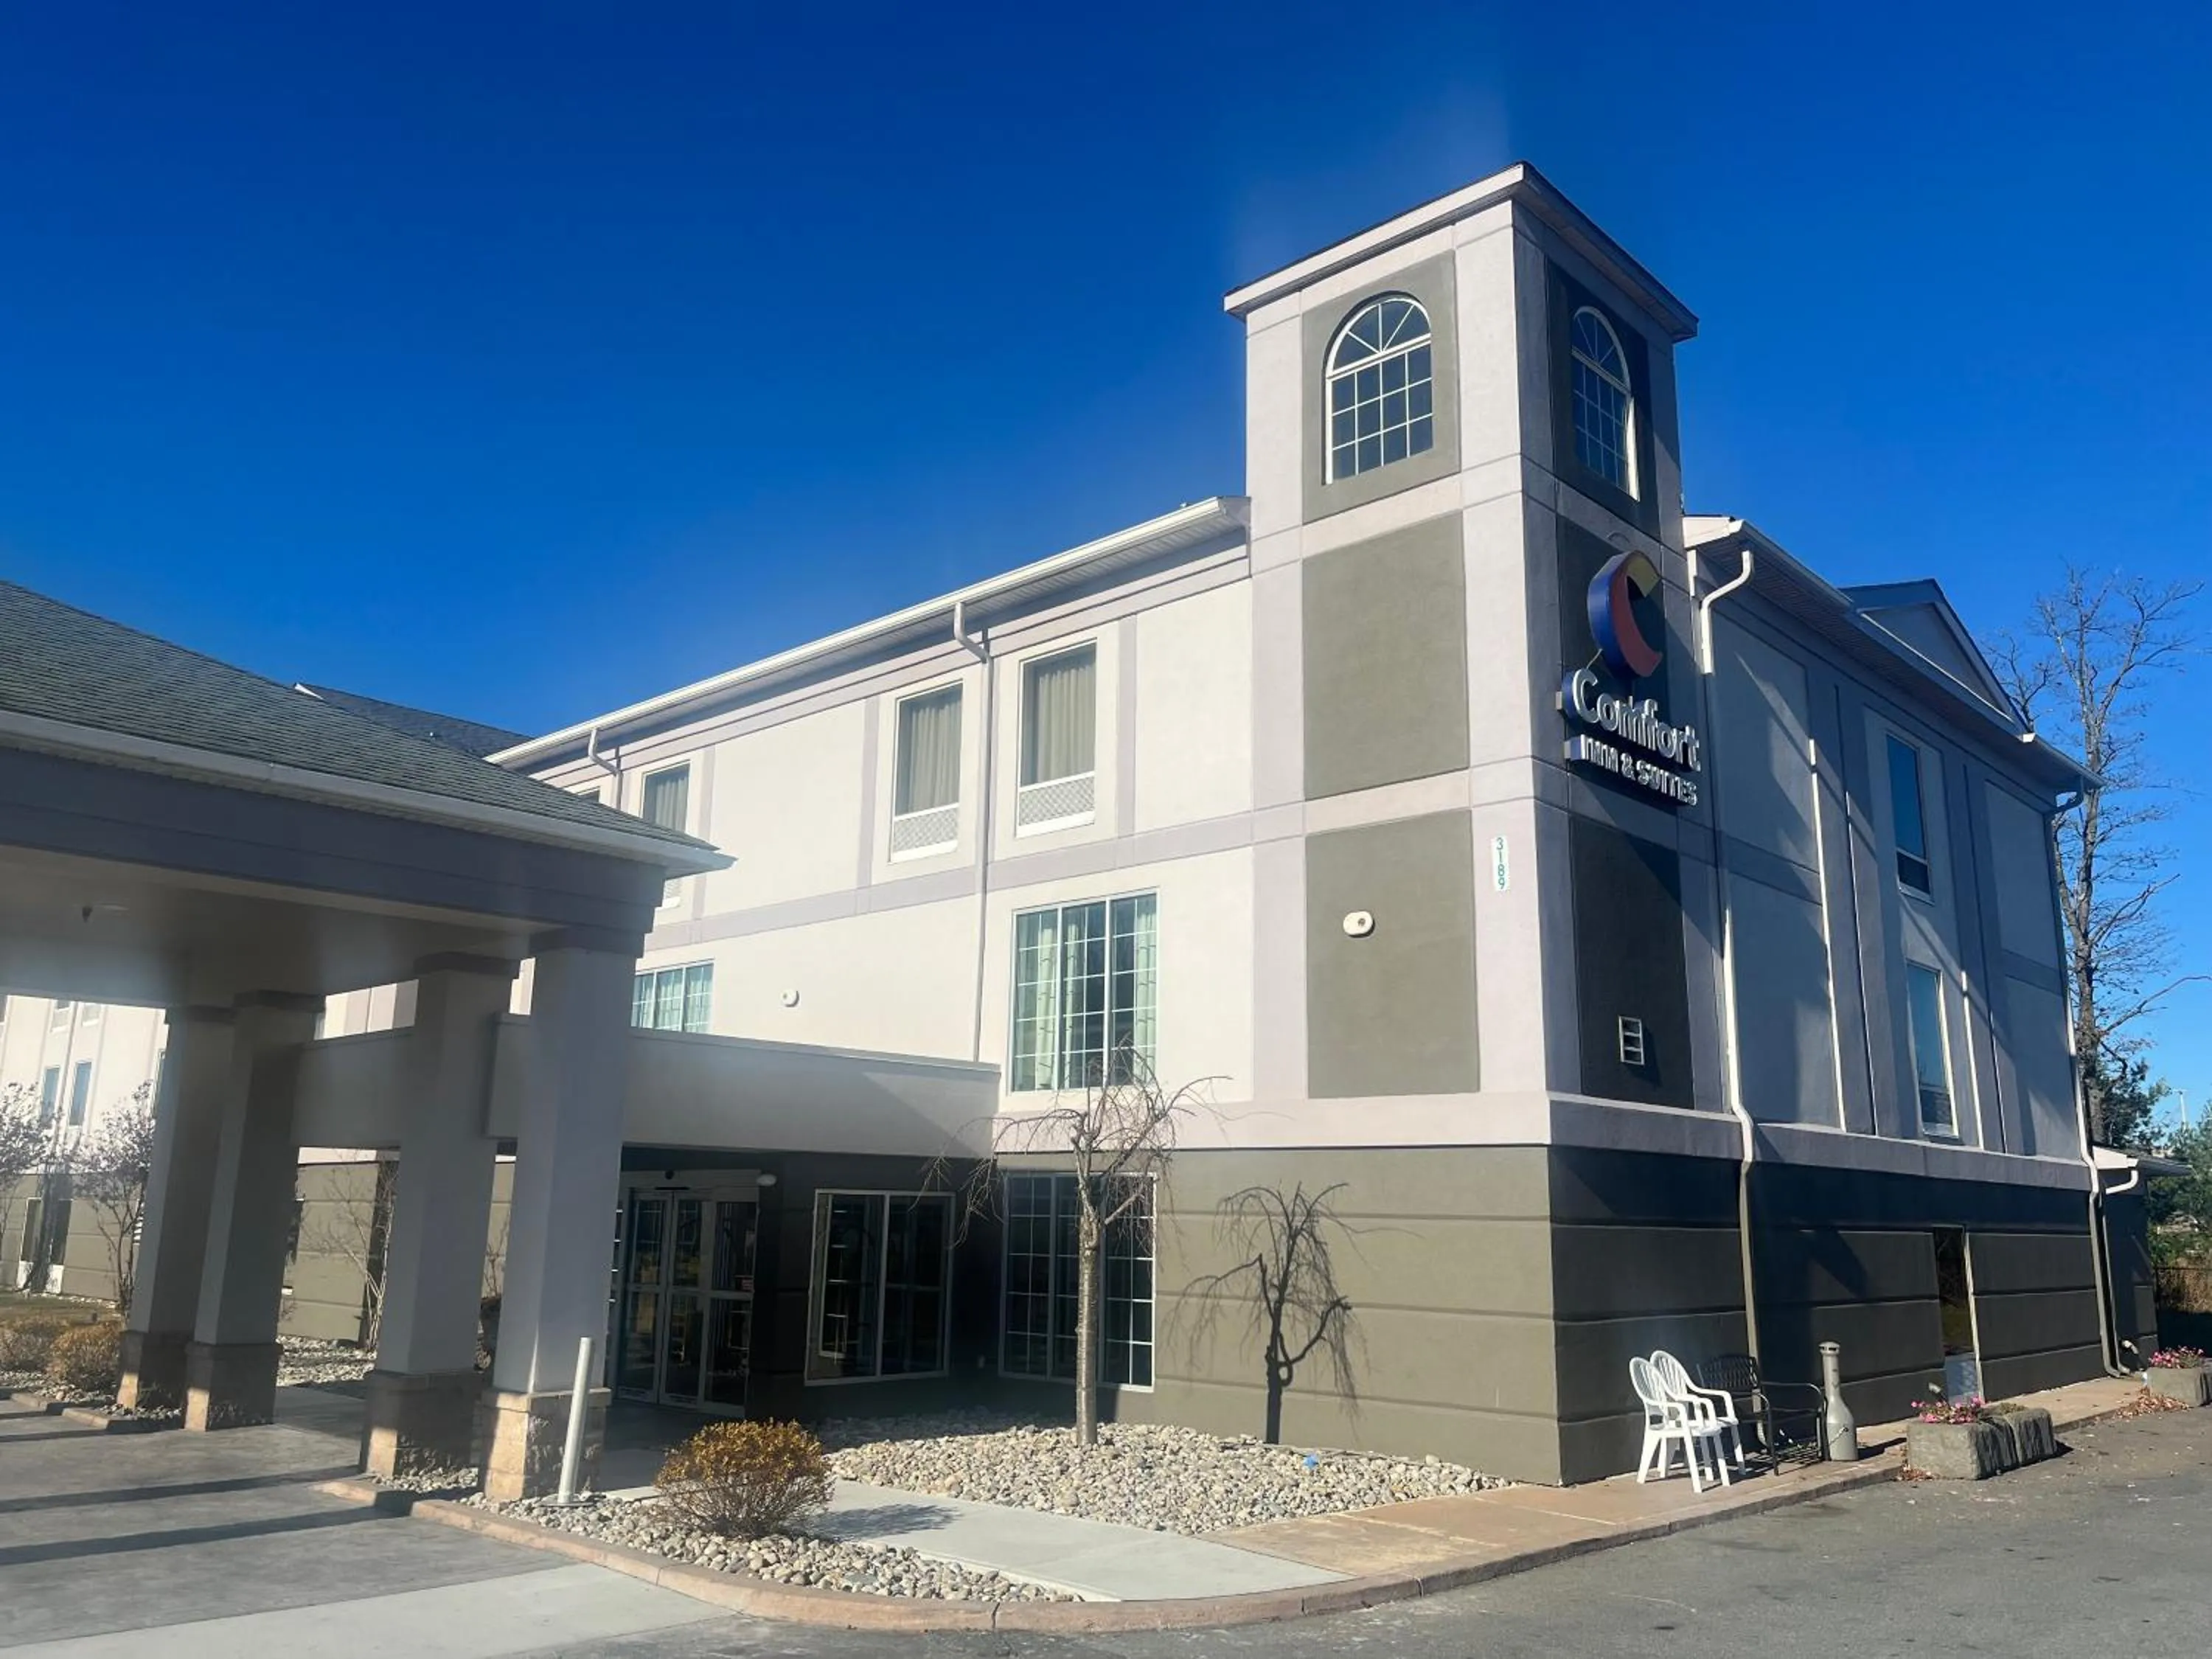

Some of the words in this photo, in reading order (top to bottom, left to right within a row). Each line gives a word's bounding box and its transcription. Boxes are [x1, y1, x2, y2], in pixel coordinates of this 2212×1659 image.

[1572, 667, 1701, 772] Comfort
[1621, 752, 1636, 781] &
[1496, 837, 1505, 889] 3189
